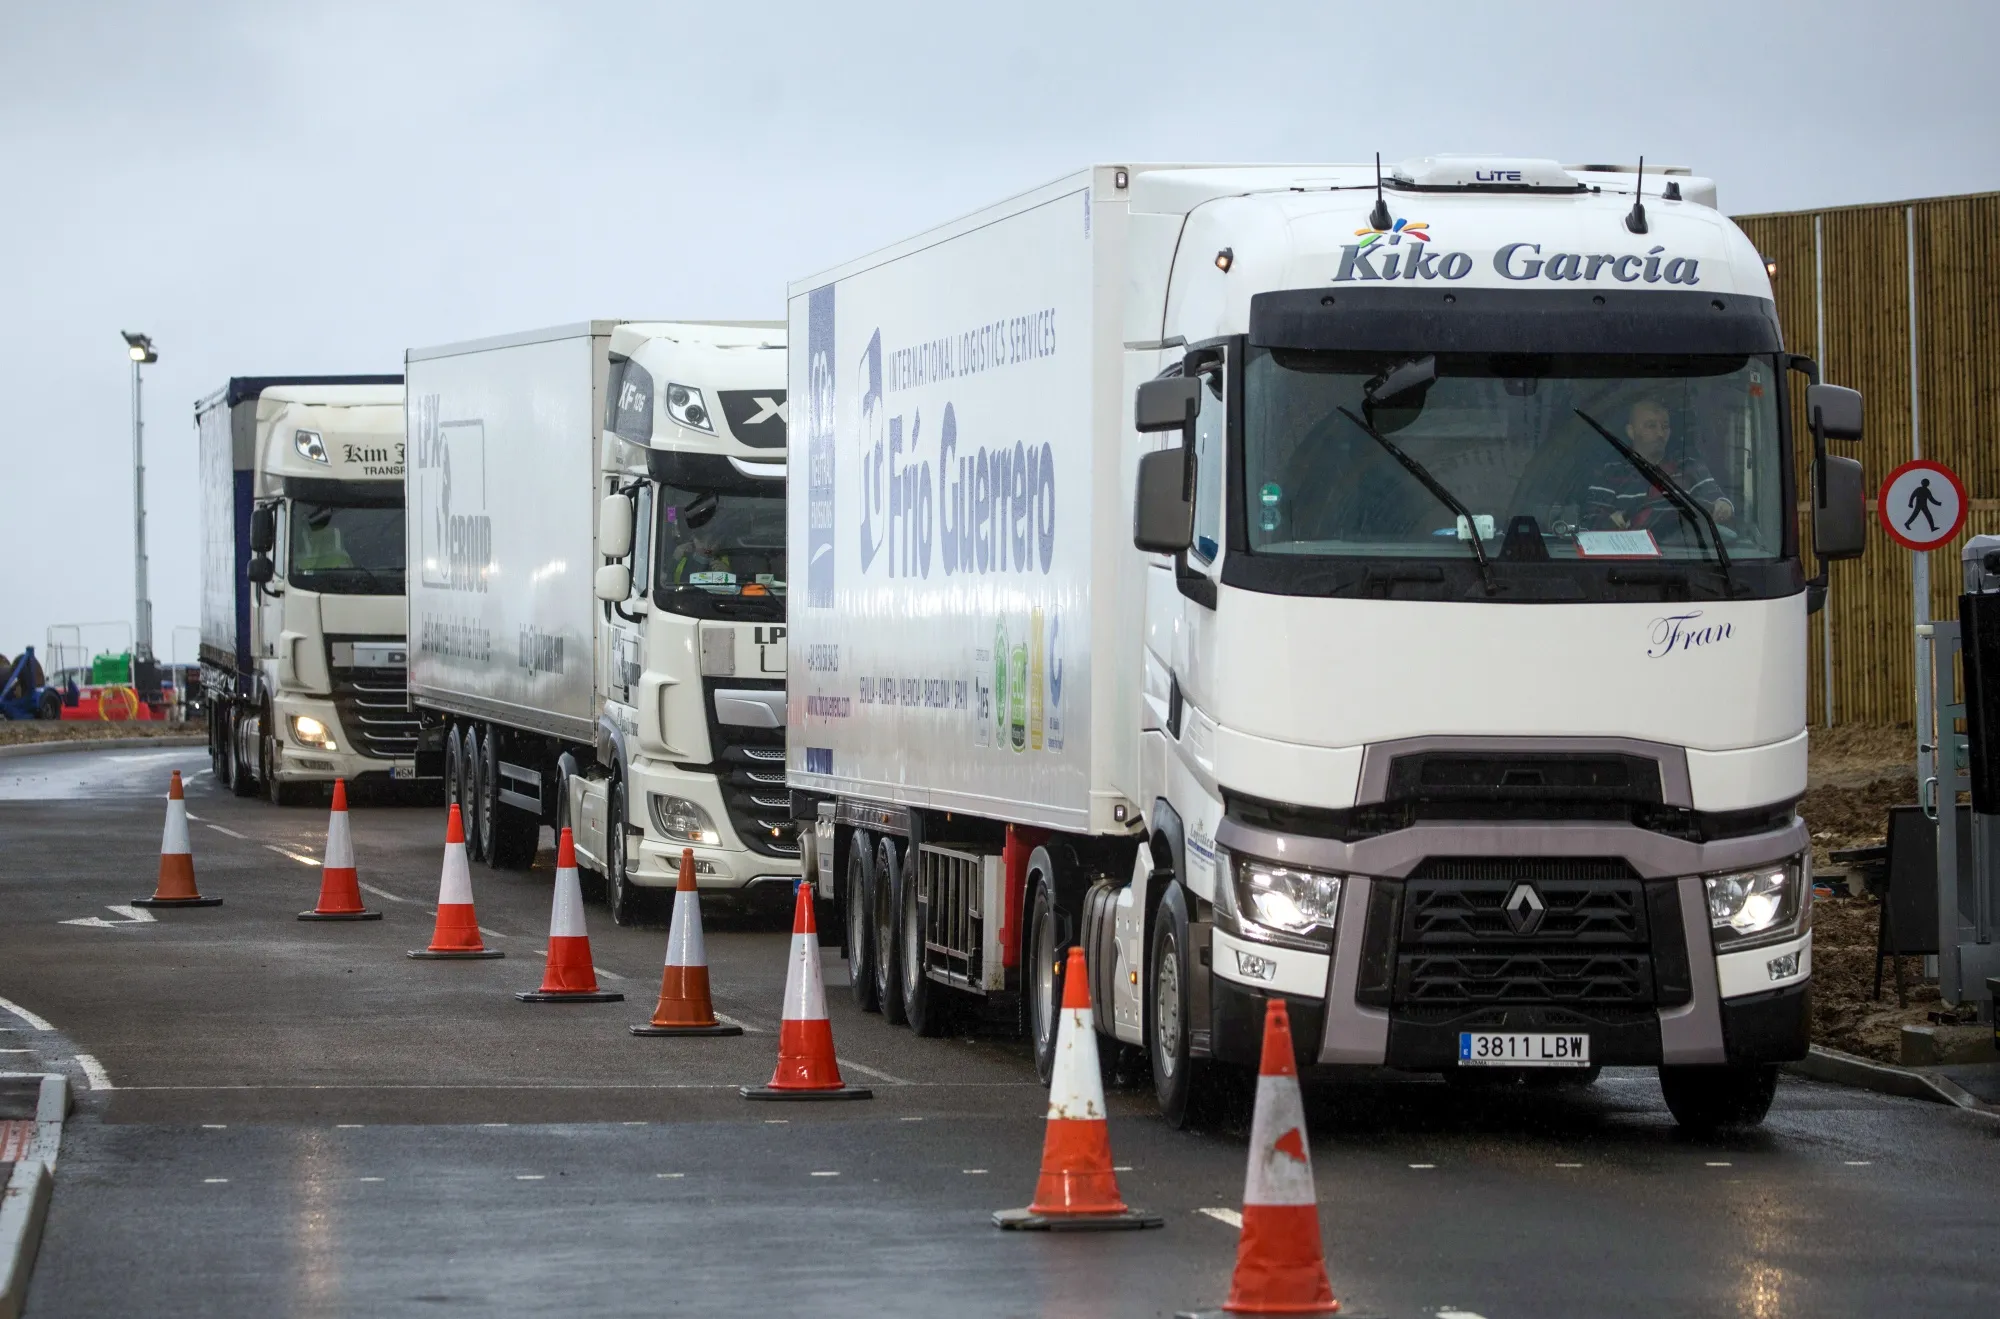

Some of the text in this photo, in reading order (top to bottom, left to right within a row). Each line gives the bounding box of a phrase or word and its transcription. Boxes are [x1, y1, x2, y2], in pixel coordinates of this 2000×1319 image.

[1331, 234, 1700, 286] Kiko García
[889, 308, 1056, 393] INTERNATIONAL LOGISTICS SERVICES
[618, 381, 636, 410] XF
[343, 444, 388, 463] Kim
[418, 393, 440, 469] LPX
[889, 401, 1055, 580] Frío Guerrero
[450, 514, 491, 593] GROUP
[755, 627, 786, 644] LP
[1647, 610, 1736, 658] Fran
[1477, 1036, 1530, 1057] 3811
[1542, 1037, 1583, 1058] LBW
